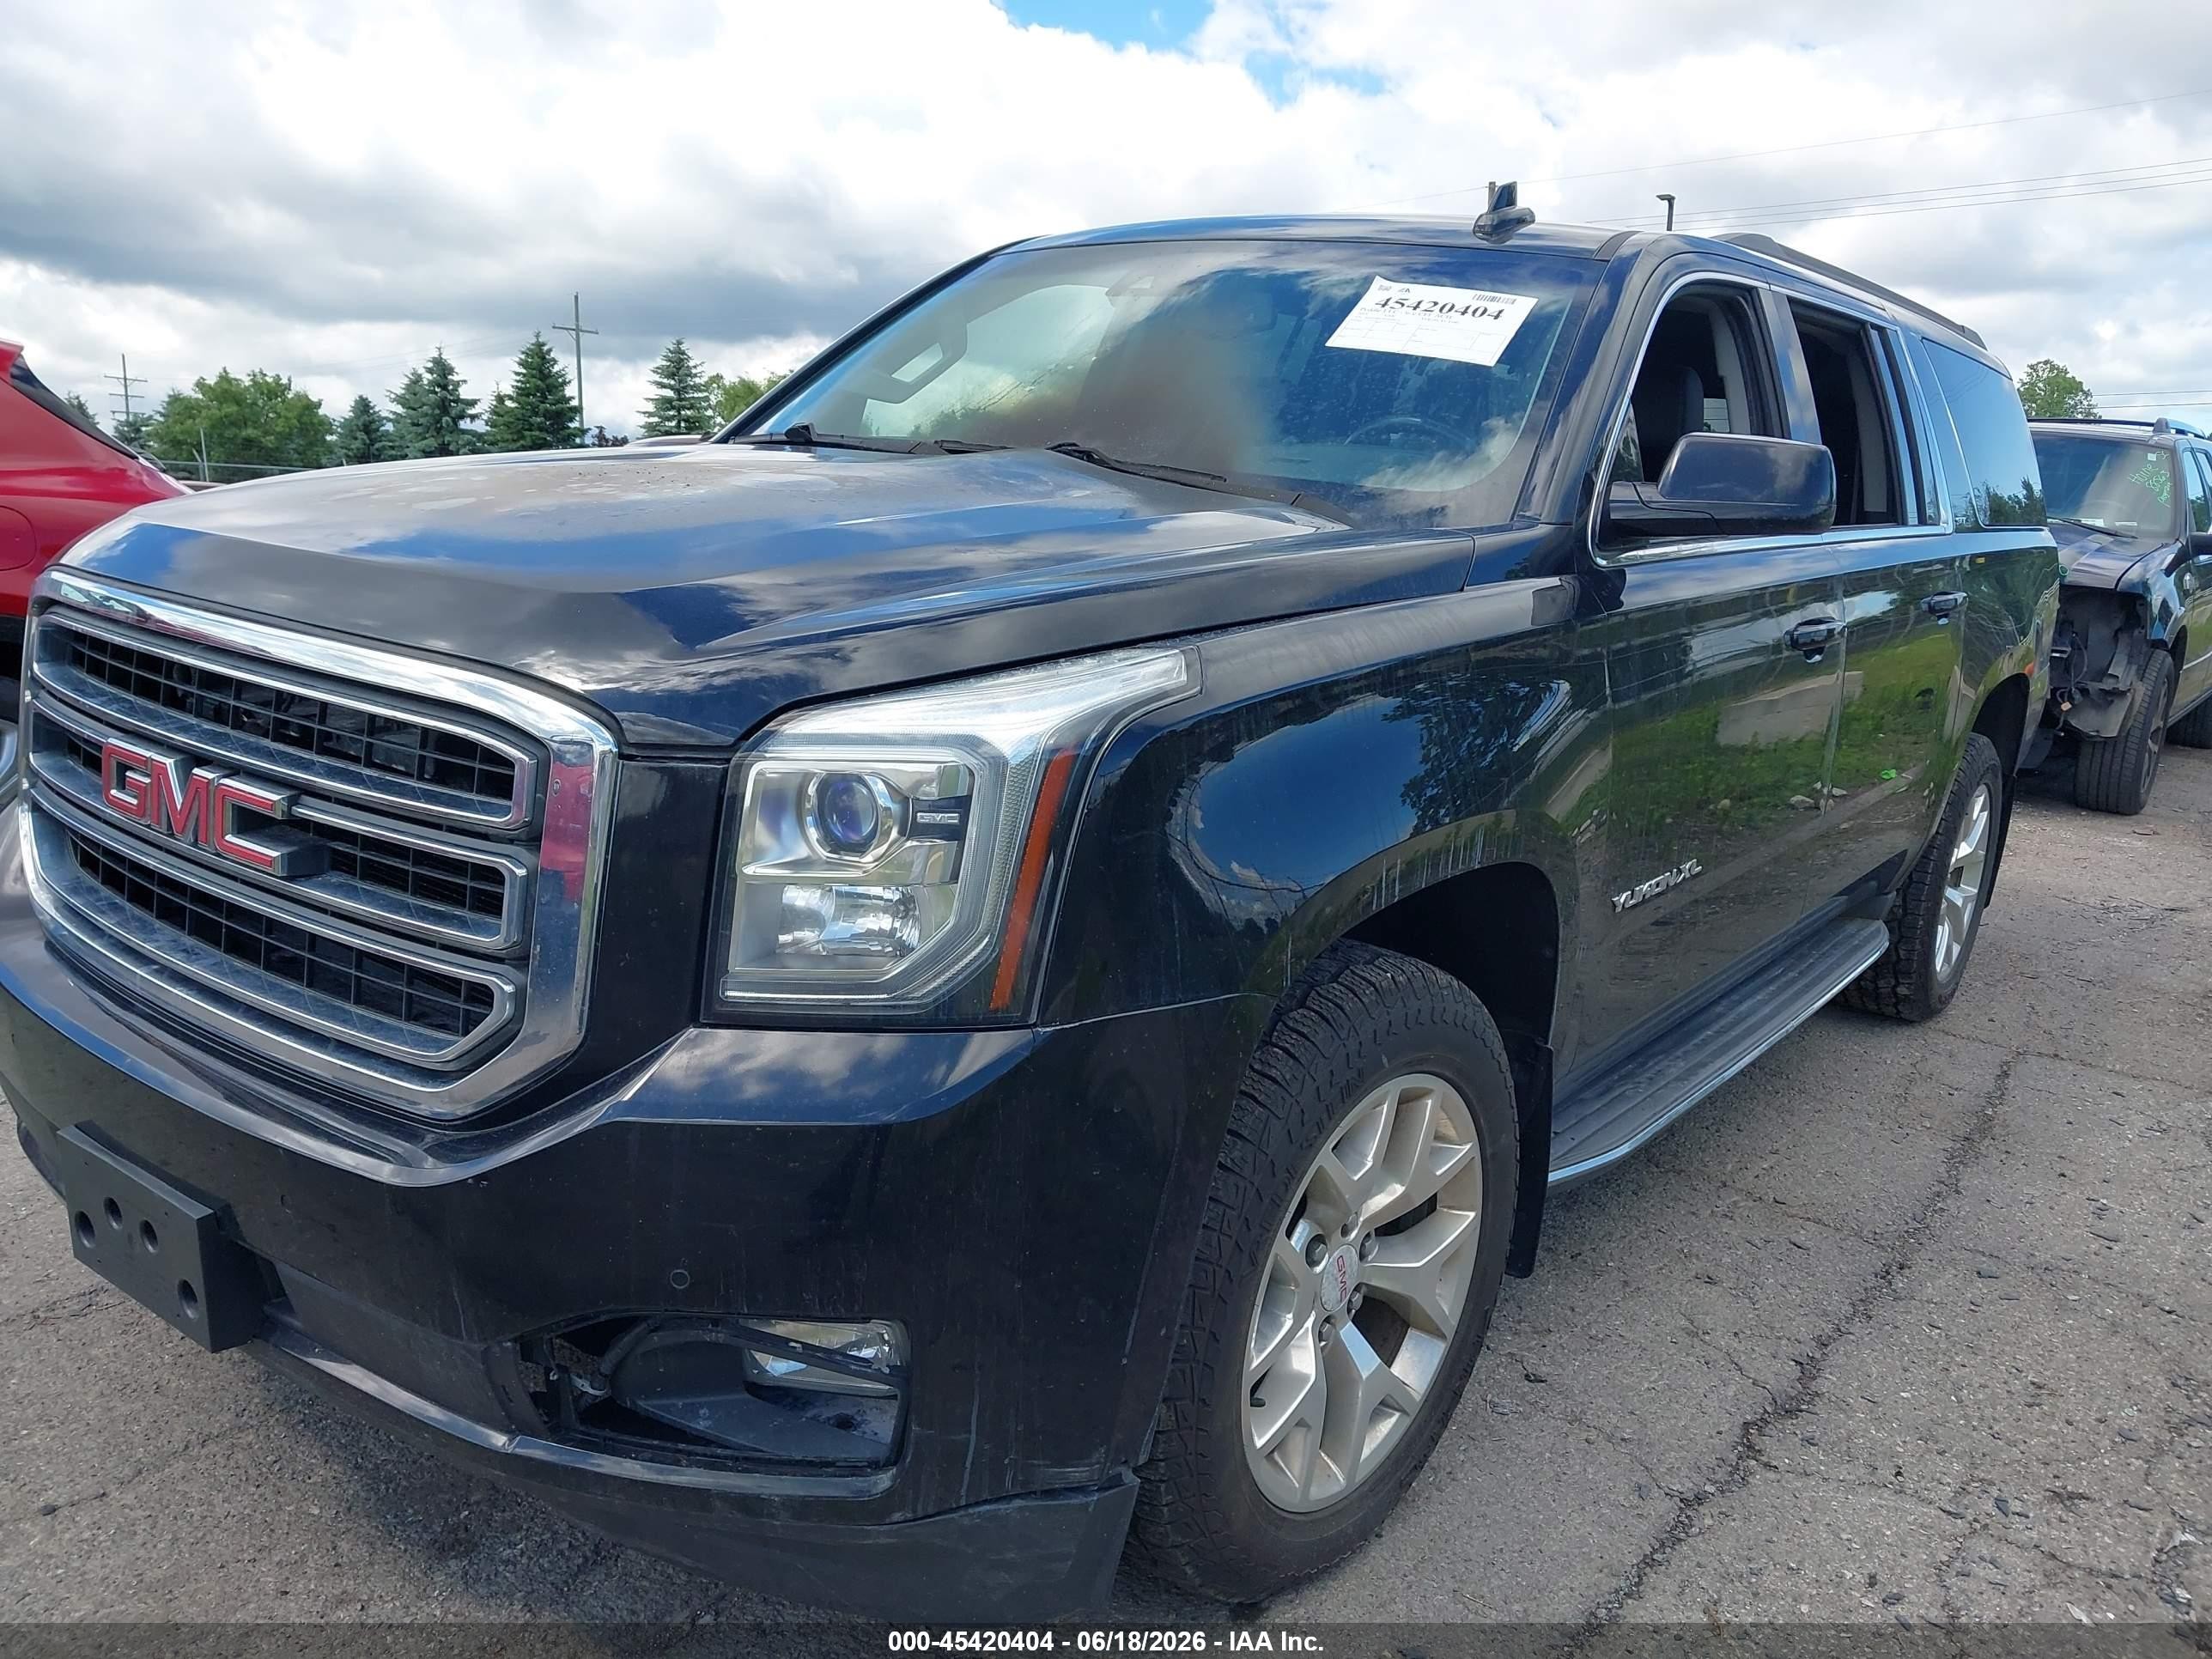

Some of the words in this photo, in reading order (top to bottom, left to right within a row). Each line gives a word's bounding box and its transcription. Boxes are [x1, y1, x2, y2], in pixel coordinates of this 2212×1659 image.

[1375, 296, 1505, 320] 45420404
[101, 738, 282, 877] GMC
[916, 812, 959, 824] GMC
[1611, 868, 1678, 913] YUKON
[1676, 859, 1703, 884] XL
[1336, 1255, 1347, 1304] GMC
